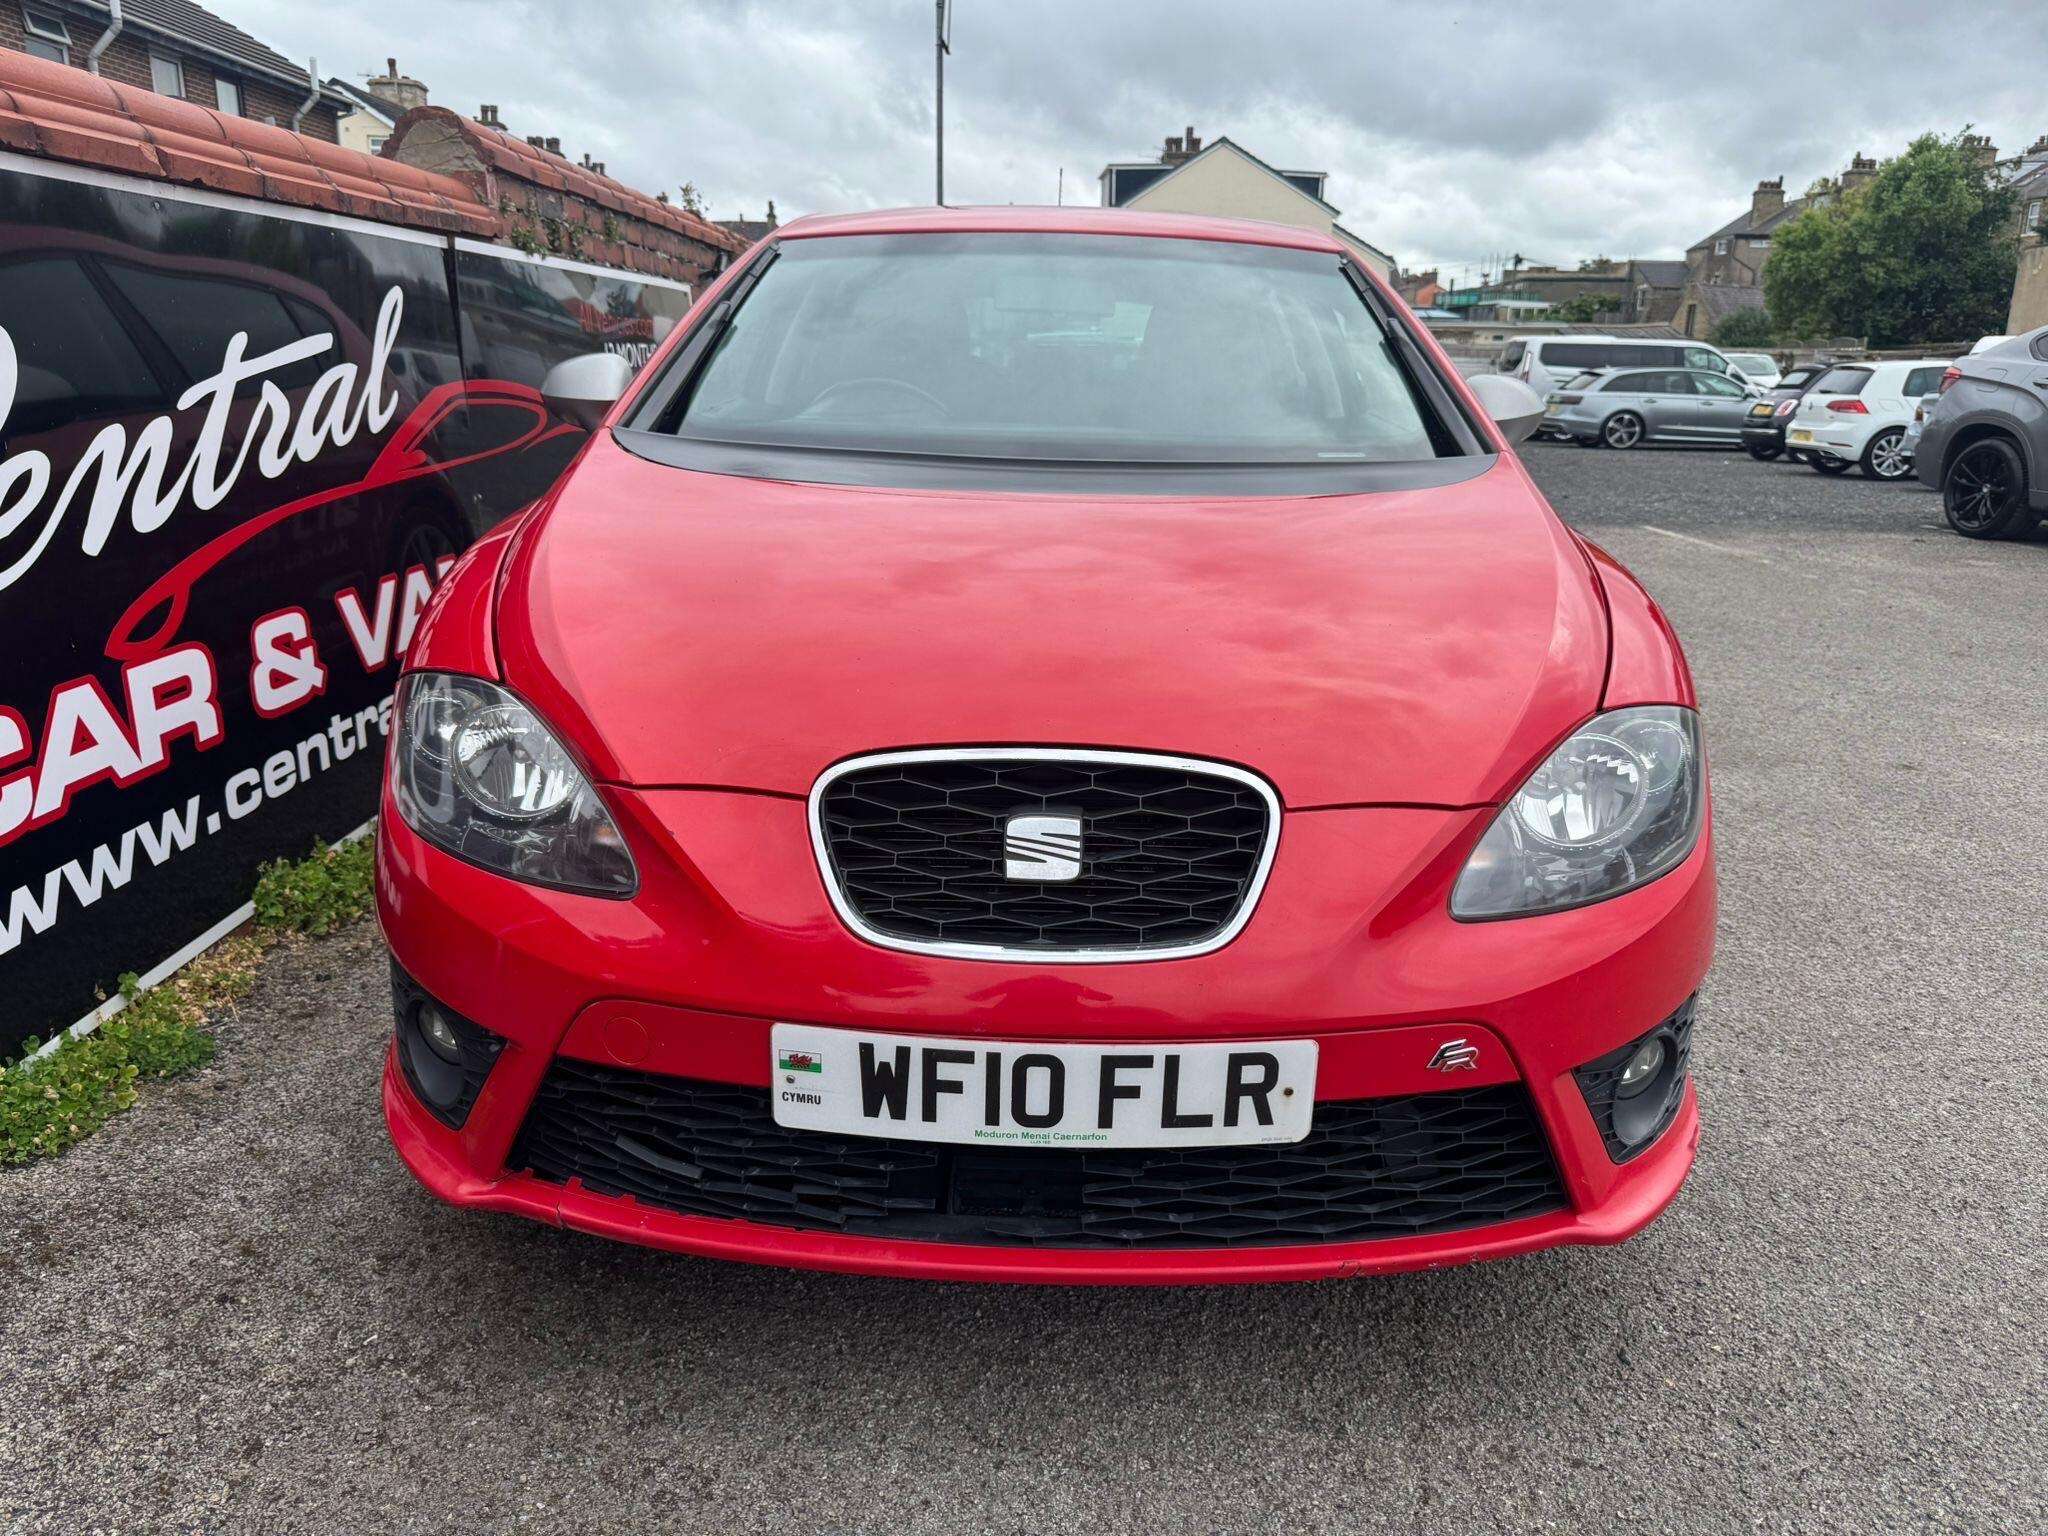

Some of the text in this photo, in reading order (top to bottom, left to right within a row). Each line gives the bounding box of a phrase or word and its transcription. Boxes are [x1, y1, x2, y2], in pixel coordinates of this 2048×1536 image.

[250, 606, 328, 718] &
[335, 555, 455, 673] VA
[781, 1091, 821, 1105] CYMRU
[858, 1042, 1280, 1129] WF10 FLR
[974, 1129, 1108, 1142] Moduron Menai Caernarfon
